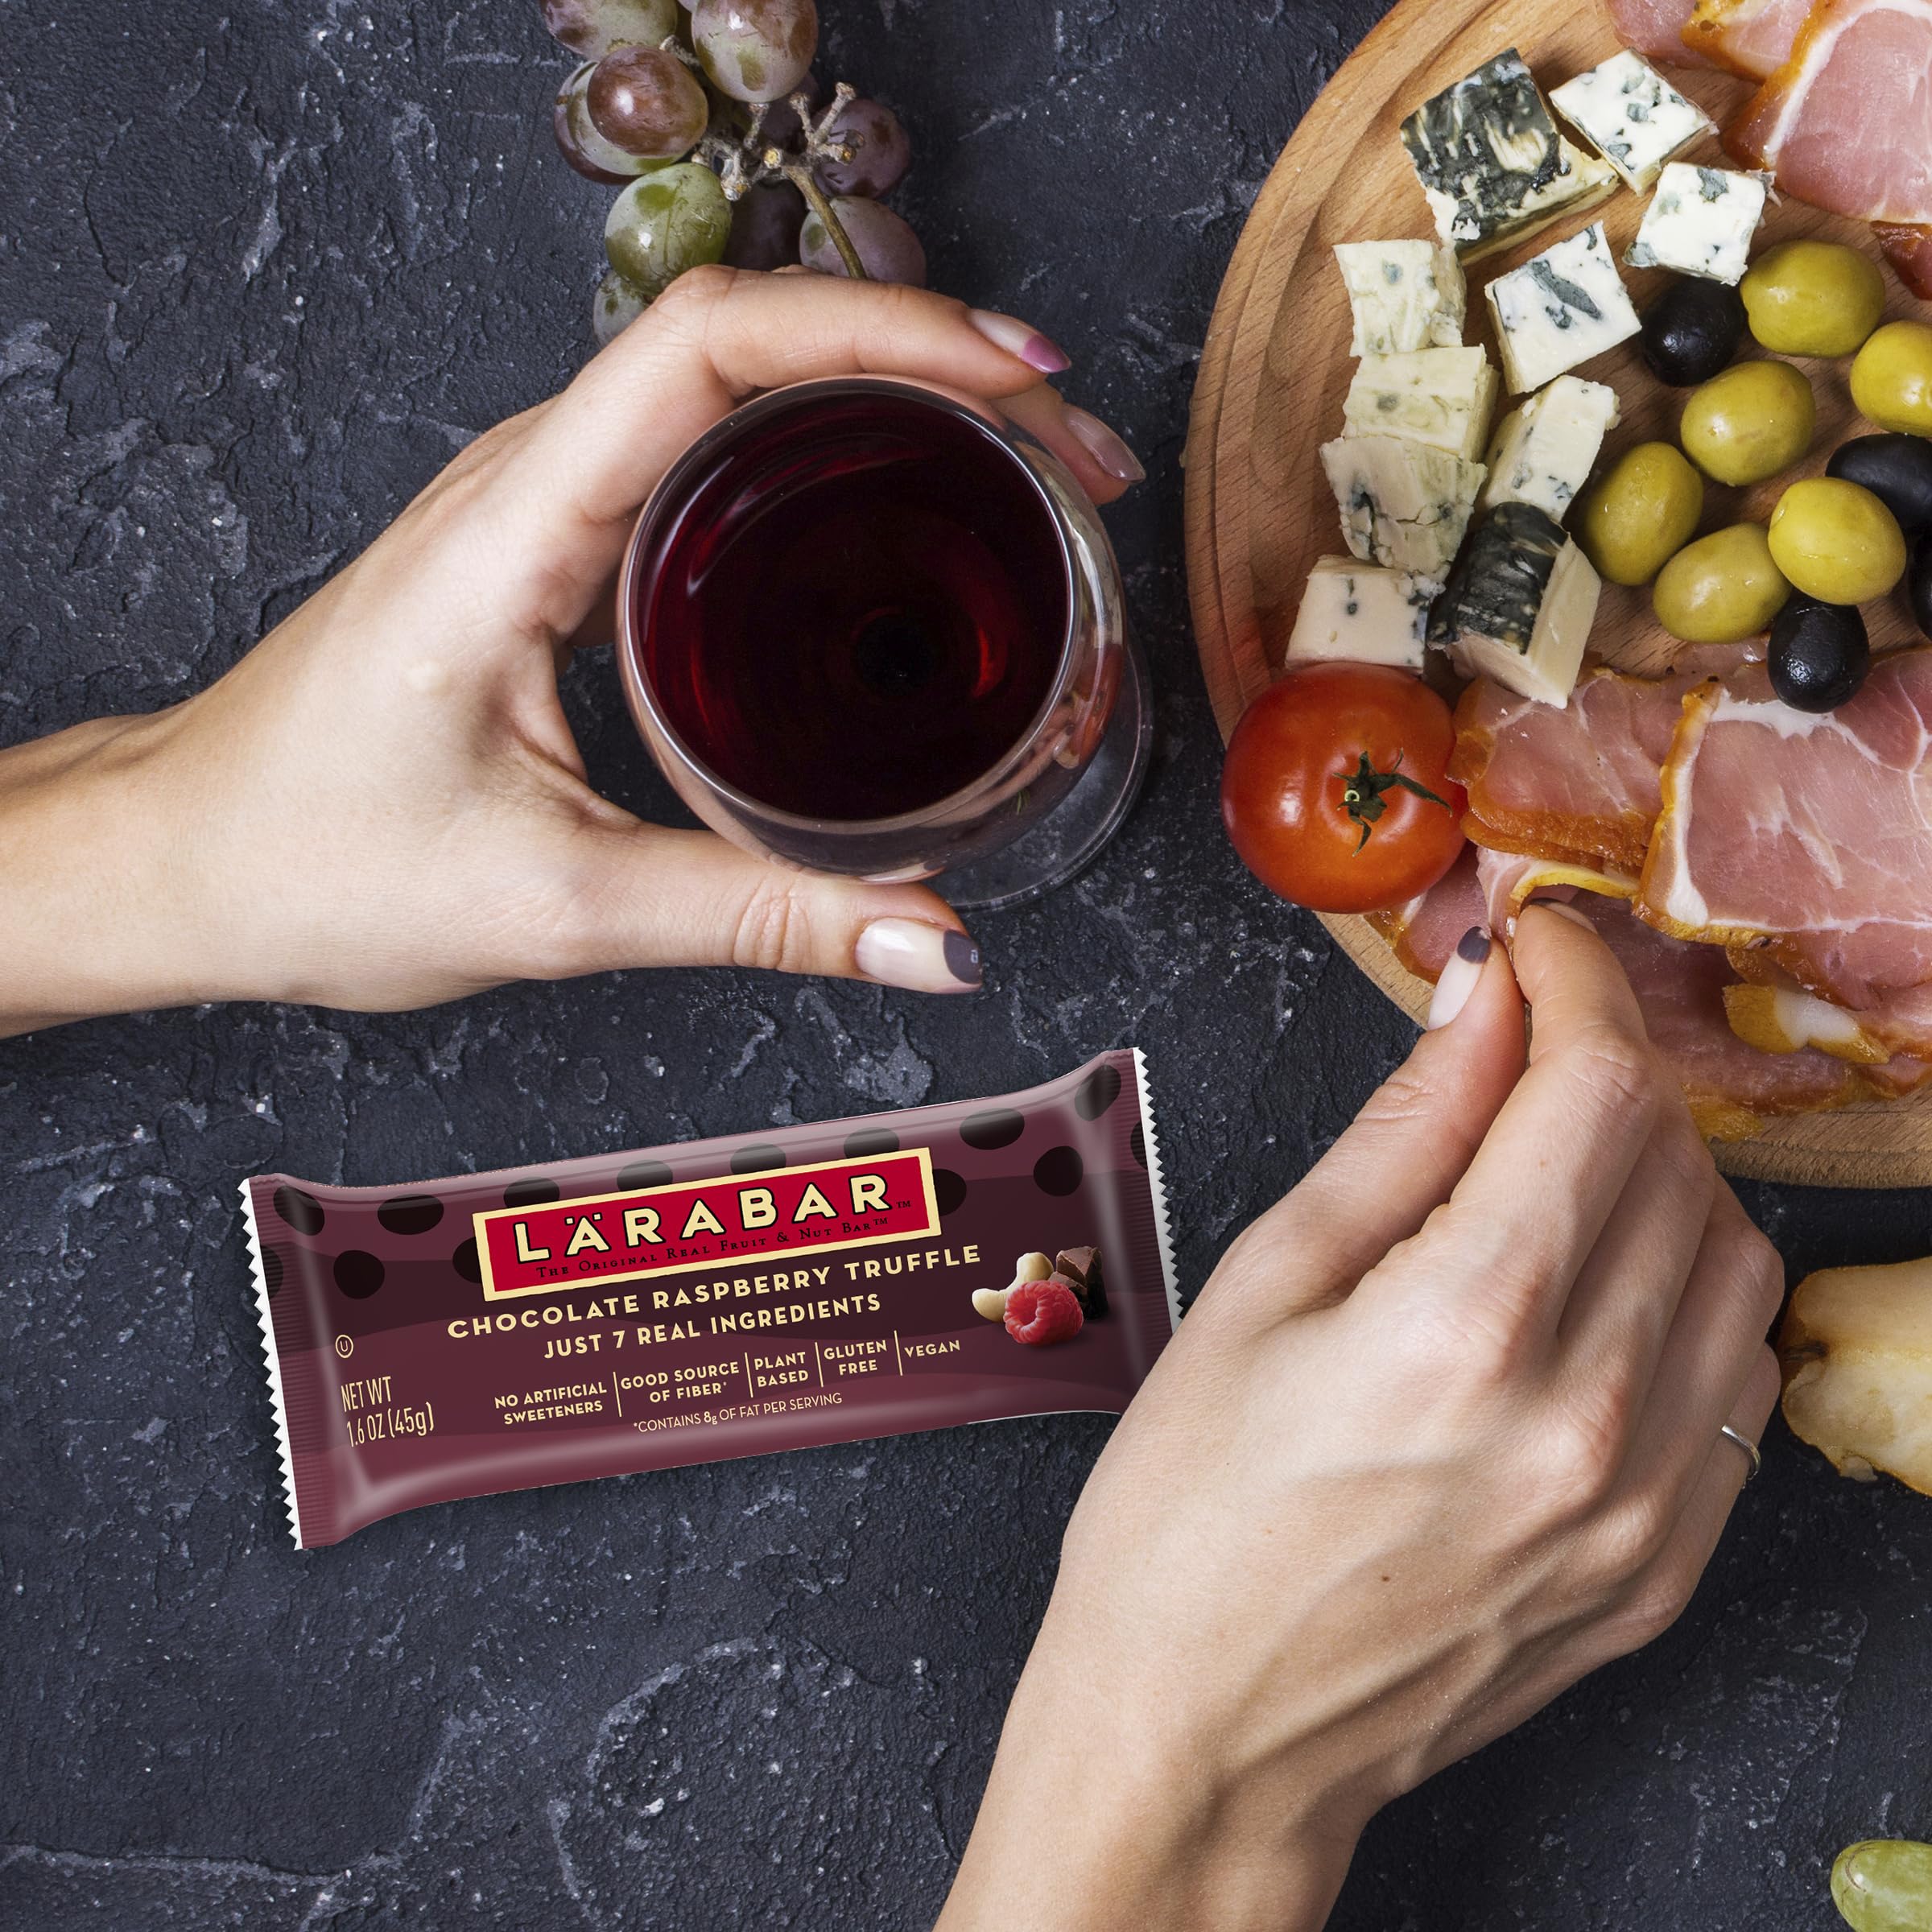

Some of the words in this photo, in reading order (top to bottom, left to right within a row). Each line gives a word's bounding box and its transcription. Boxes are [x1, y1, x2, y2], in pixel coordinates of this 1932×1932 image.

[777, 1231, 789, 1243] &
[447, 1294, 639, 1338] CHOCOLATE
[653, 1267, 830, 1310] RASPBERRY
[844, 1245, 980, 1280] TRUFFLE
[544, 1335, 601, 1359] JUST
[613, 1331, 625, 1348] 7
[637, 1320, 701, 1346] REAL
[711, 1293, 881, 1334] INGREDIENTS
[754, 1352, 806, 1371] PLANT
[824, 1340, 888, 1360] GLUTEN
[904, 1340, 961, 1358] VEGAN
[620, 1372, 669, 1390] GOOD
[674, 1361, 740, 1383] SOURCE
[757, 1369, 809, 1388] BASED
[839, 1359, 878, 1376] FREE
[341, 1381, 365, 1412] NET
[365, 1376, 392, 1404] WT
[494, 1394, 519, 1410] NO
[523, 1381, 608, 1406] ARTIFICIAL
[650, 1391, 671, 1403] OF
[503, 1400, 603, 1426] SWEETENERS
[703, 1410, 718, 1425] 8g
[719, 1408, 737, 1422] OF
[739, 1404, 761, 1418] FAT
[763, 1399, 787, 1414] PER
[789, 1392, 843, 1410] SERVING
[346, 1418, 365, 1448] 1.6
[367, 1413, 386, 1441] OZ
[387, 1402, 435, 1436] (45g)
